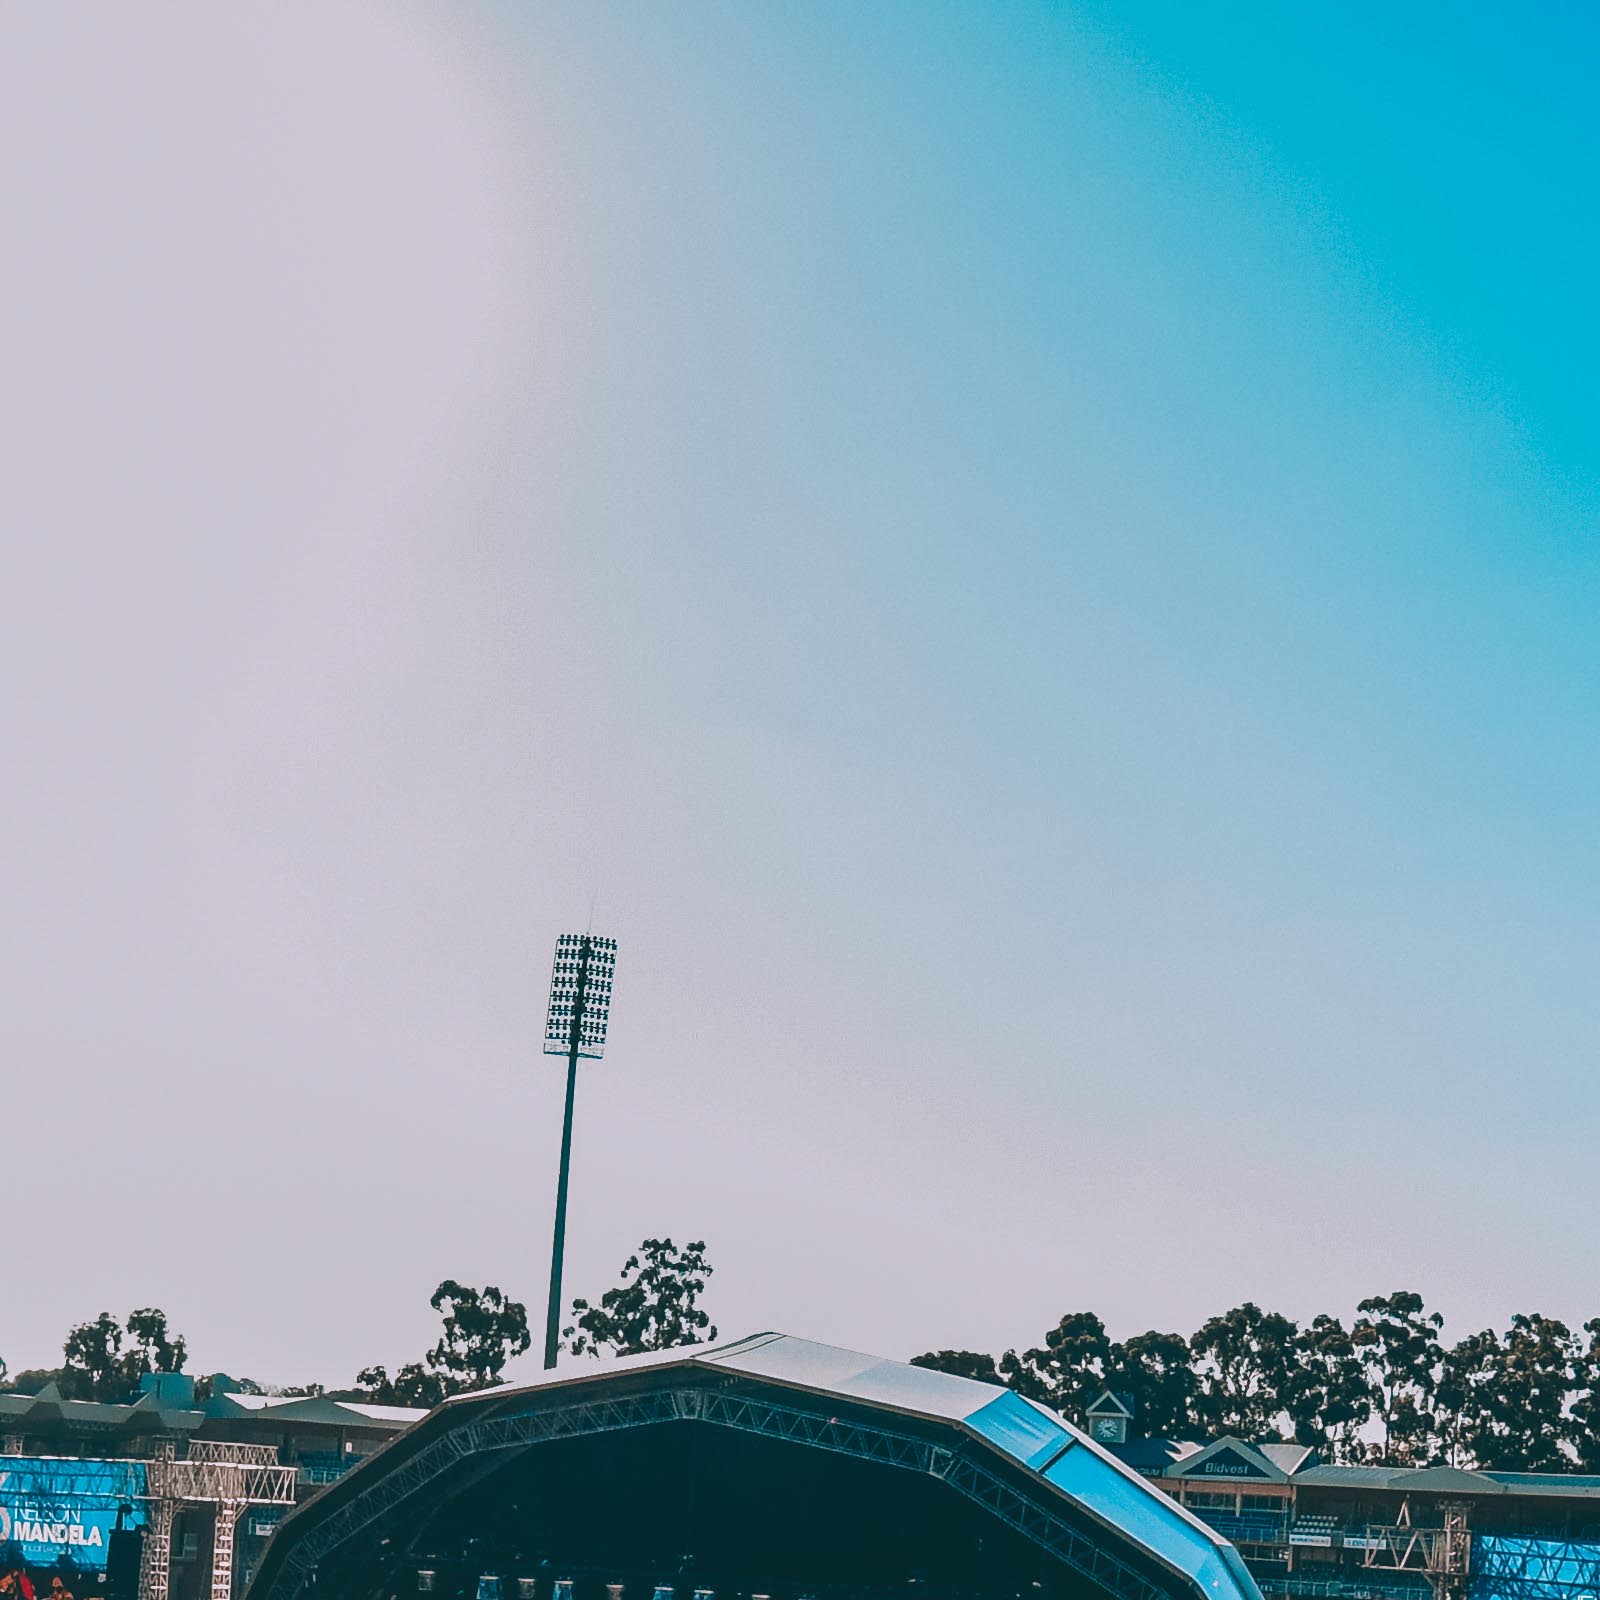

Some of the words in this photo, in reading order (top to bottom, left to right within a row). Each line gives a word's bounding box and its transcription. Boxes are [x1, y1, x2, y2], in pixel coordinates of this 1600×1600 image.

[1205, 1463, 1248, 1474] Bidvest
[15, 1500, 81, 1524] NELSON
[14, 1521, 103, 1547] MANDELA
